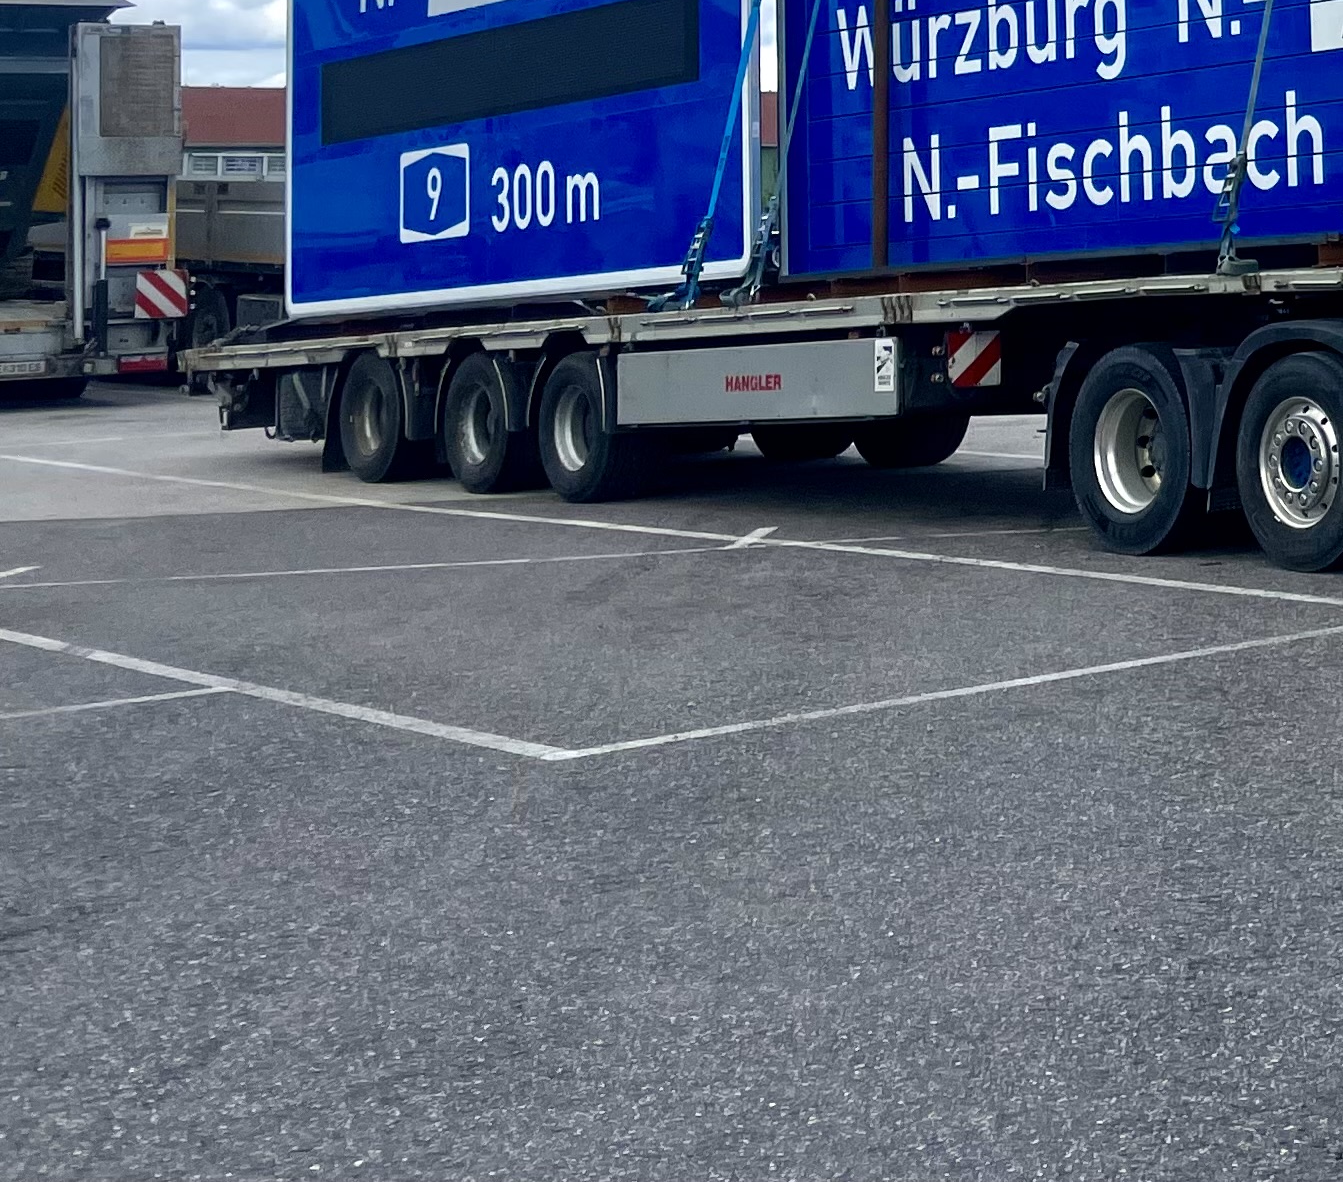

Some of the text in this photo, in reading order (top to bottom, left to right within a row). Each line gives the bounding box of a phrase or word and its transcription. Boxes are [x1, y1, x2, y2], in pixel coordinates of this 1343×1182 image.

[903, 90, 1324, 223] N.-Fischbach
[427, 167, 442, 220] 9
[491, 160, 600, 233] 300 m
[725, 374, 782, 392] HANGLER
